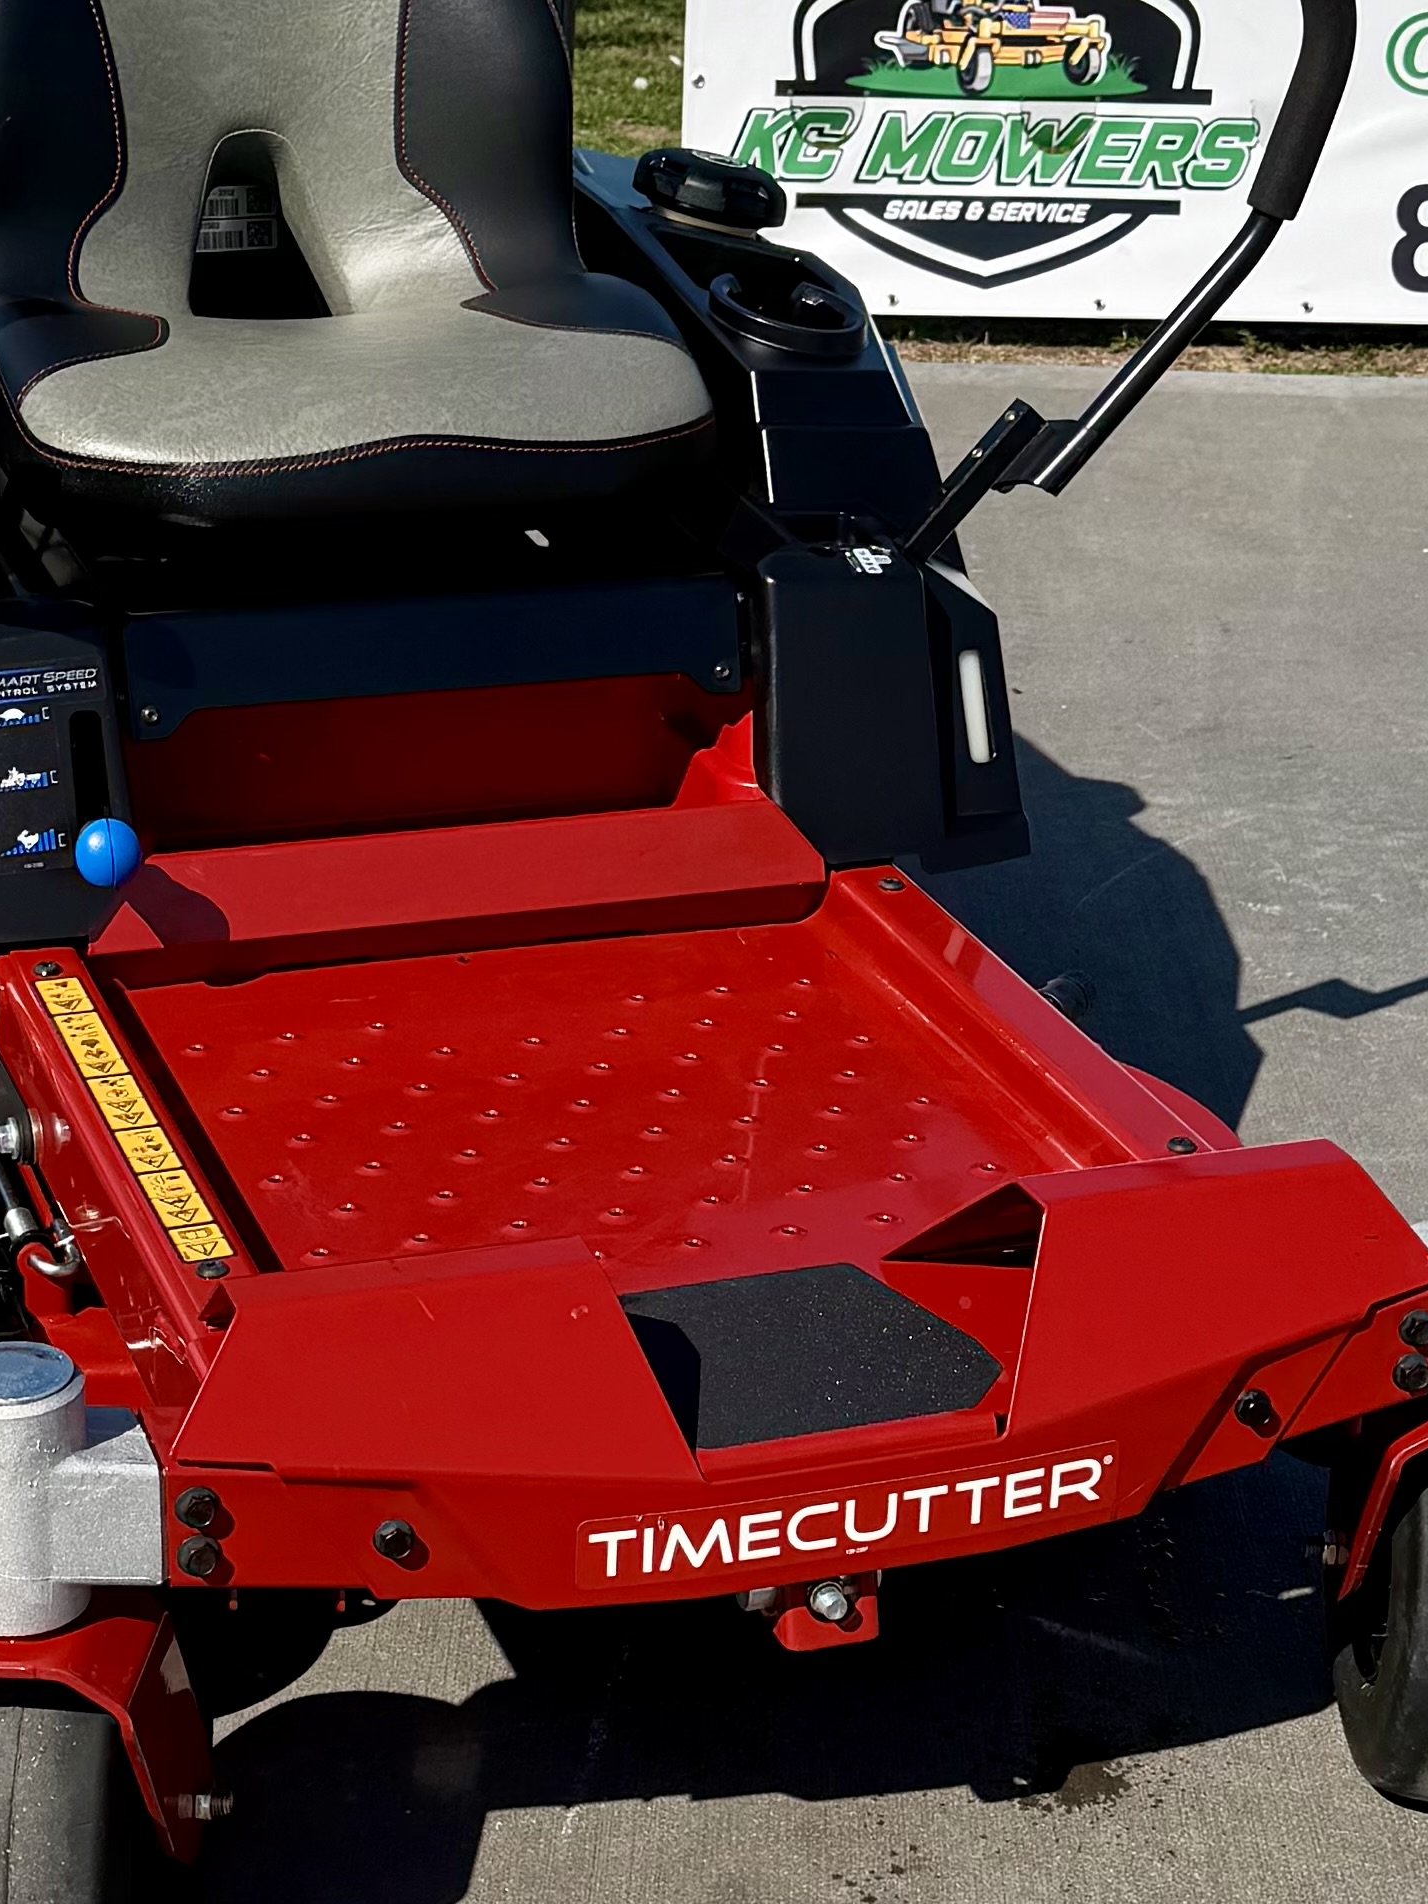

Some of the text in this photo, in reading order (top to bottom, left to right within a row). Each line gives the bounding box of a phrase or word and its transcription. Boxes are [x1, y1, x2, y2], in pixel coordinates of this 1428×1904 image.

[734, 108, 1260, 189] KC MOWERS
[884, 199, 1090, 224] SALES & SERVICE
[43, 668, 98, 684] SPEED
[46, 680, 98, 693] SYSTEM
